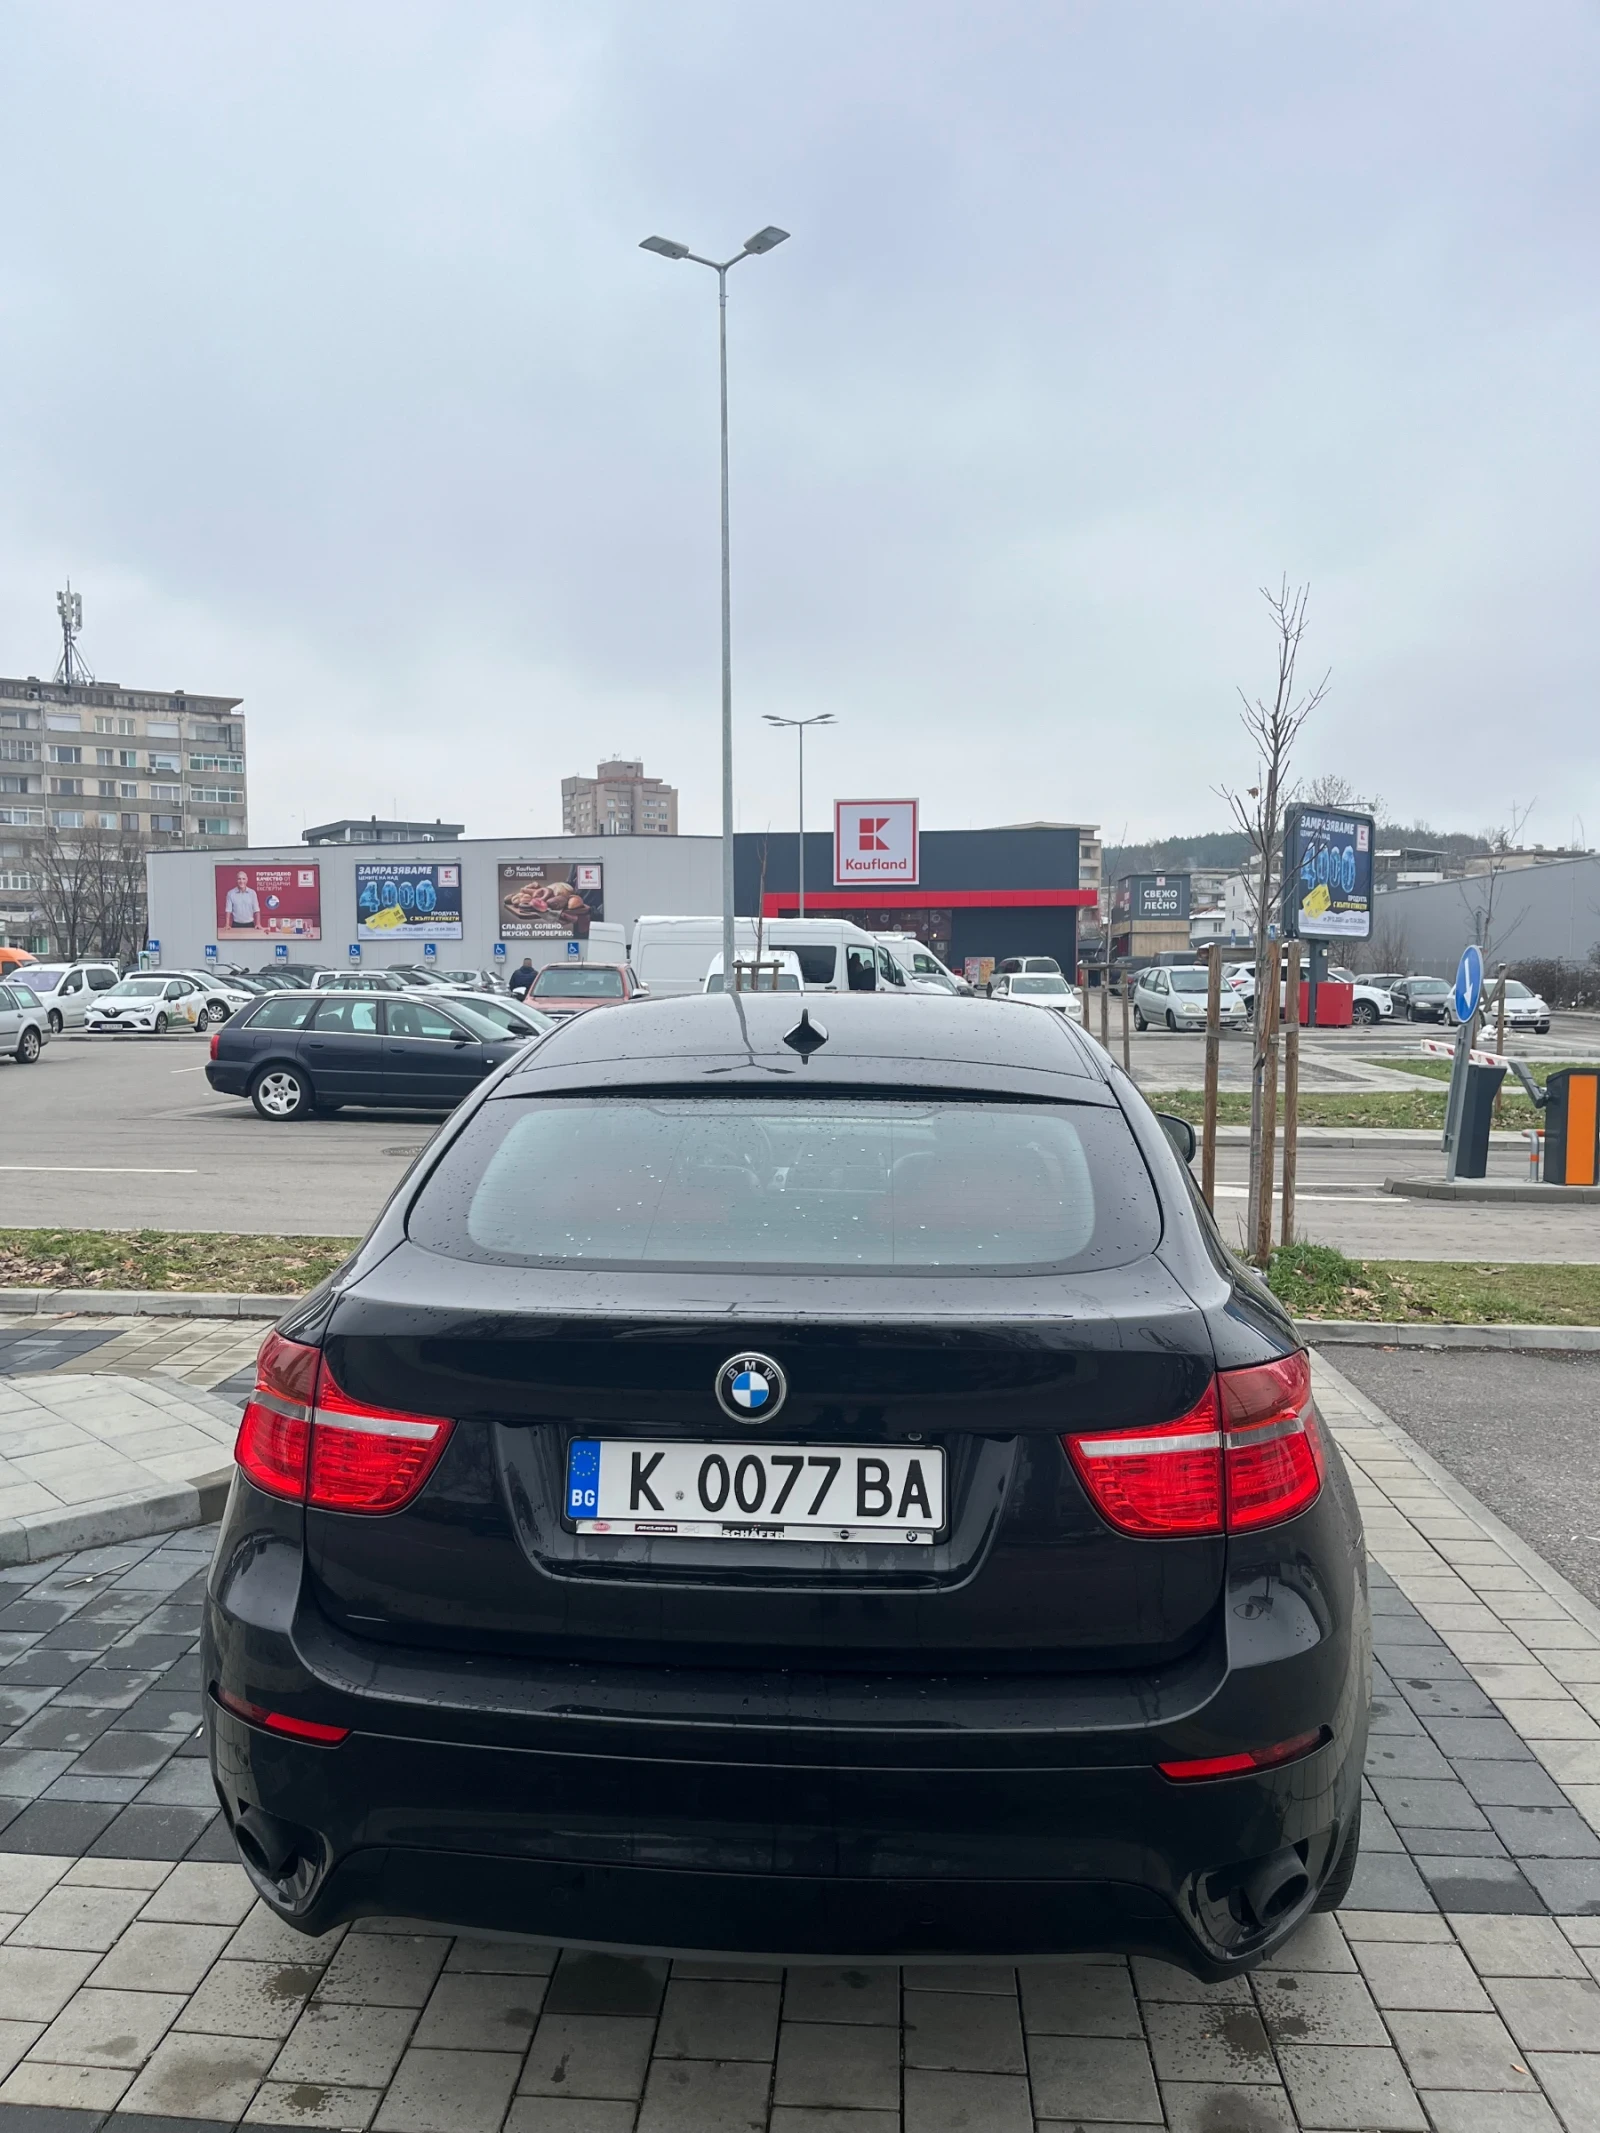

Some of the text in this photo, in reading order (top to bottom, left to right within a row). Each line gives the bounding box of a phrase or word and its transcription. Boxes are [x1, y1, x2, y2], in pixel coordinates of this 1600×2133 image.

[1300, 815, 1355, 835] ЗАМРАЗЯВАМЕ
[358, 866, 433, 875] ЗАМРАЗЯВАМЕ
[845, 858, 907, 870] Kaufland
[1300, 841, 1356, 893] 4000
[359, 879, 437, 912] 4000
[1143, 889, 1178, 899] СВЕЖО
[1143, 901, 1178, 910] ЛЕСНО
[726, 1360, 776, 1381] BMW
[629, 1451, 933, 1519] K 0077 BA
[571, 1489, 596, 1507] BG
[722, 1528, 784, 1539] SCHÄFER
